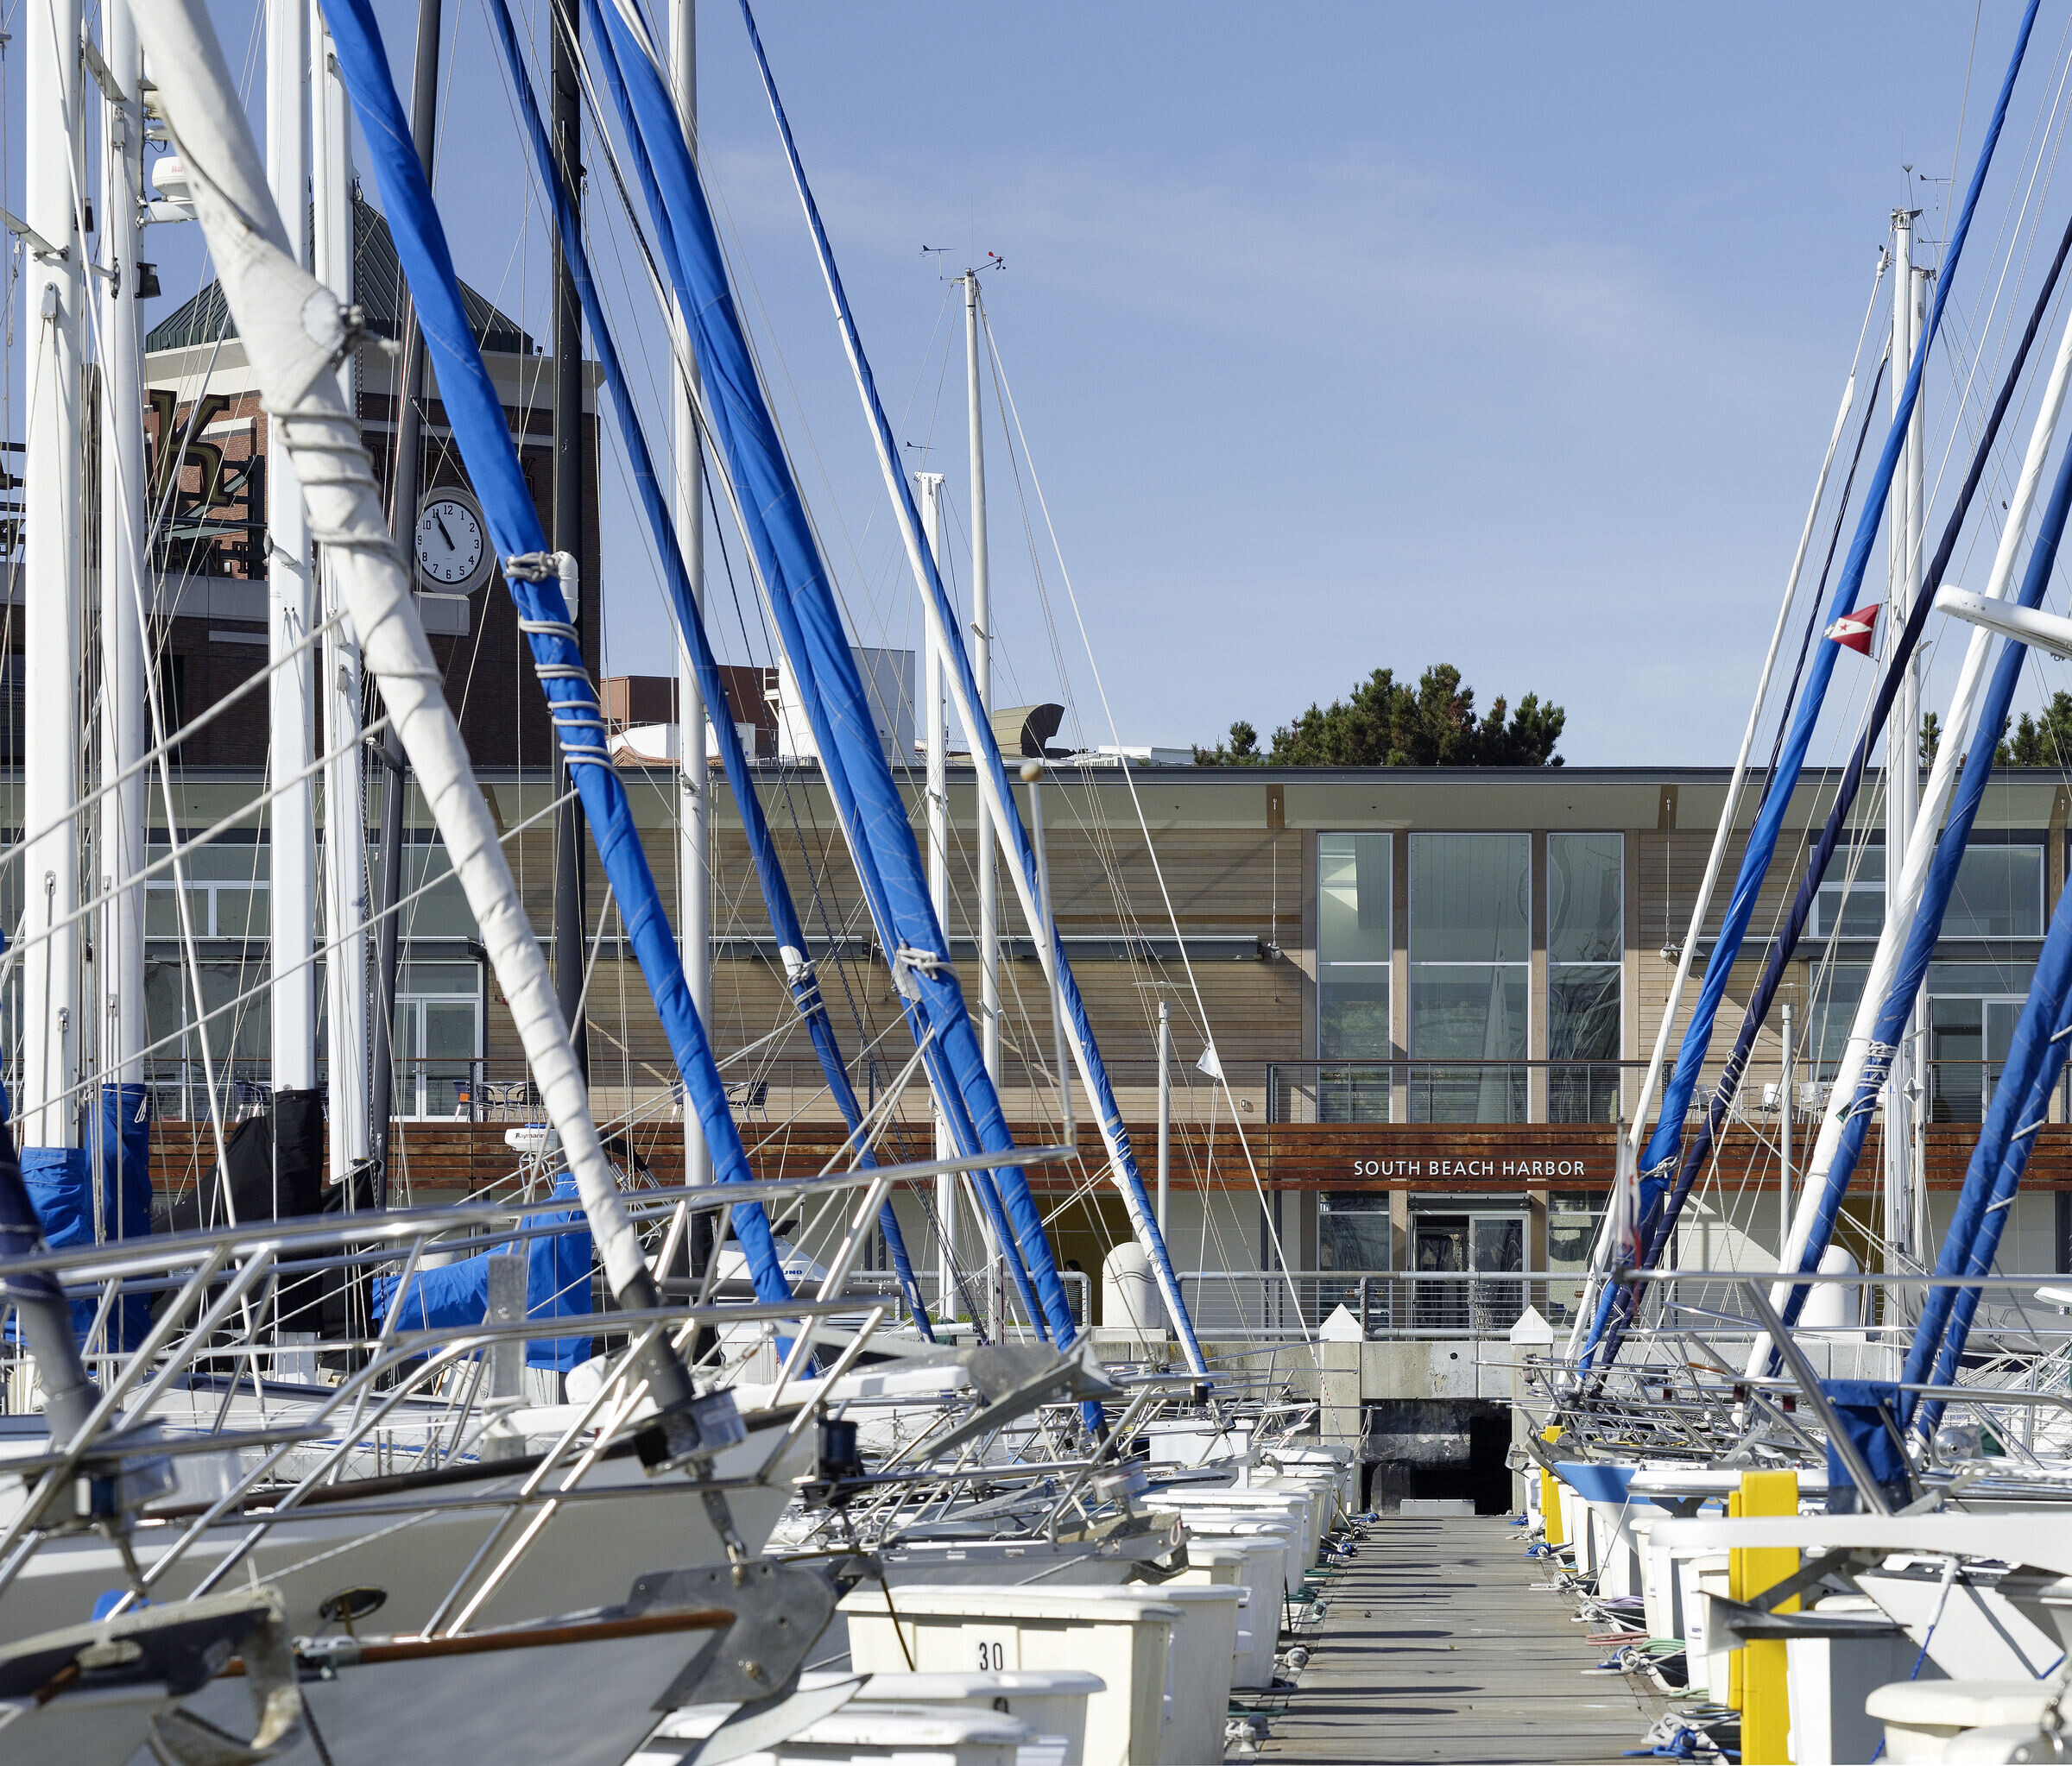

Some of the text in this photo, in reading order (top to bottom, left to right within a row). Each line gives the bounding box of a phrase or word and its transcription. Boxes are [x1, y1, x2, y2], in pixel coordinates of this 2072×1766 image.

[432, 508, 439, 519] 11
[443, 505, 453, 515] 12
[460, 510, 464, 520] 1
[422, 520, 432, 530] 10
[469, 522, 475, 533] 2
[417, 535, 422, 546] 9
[474, 539, 480, 549] 3
[422, 552, 427, 562] 8
[468, 555, 475, 565] 4
[433, 564, 439, 574] 7
[459, 566, 464, 576] 5
[445, 570, 452, 579] 6
[1354, 1161, 1585, 1176] SOUTH BEACH HARBOR
[979, 1642, 1003, 1671] 30
